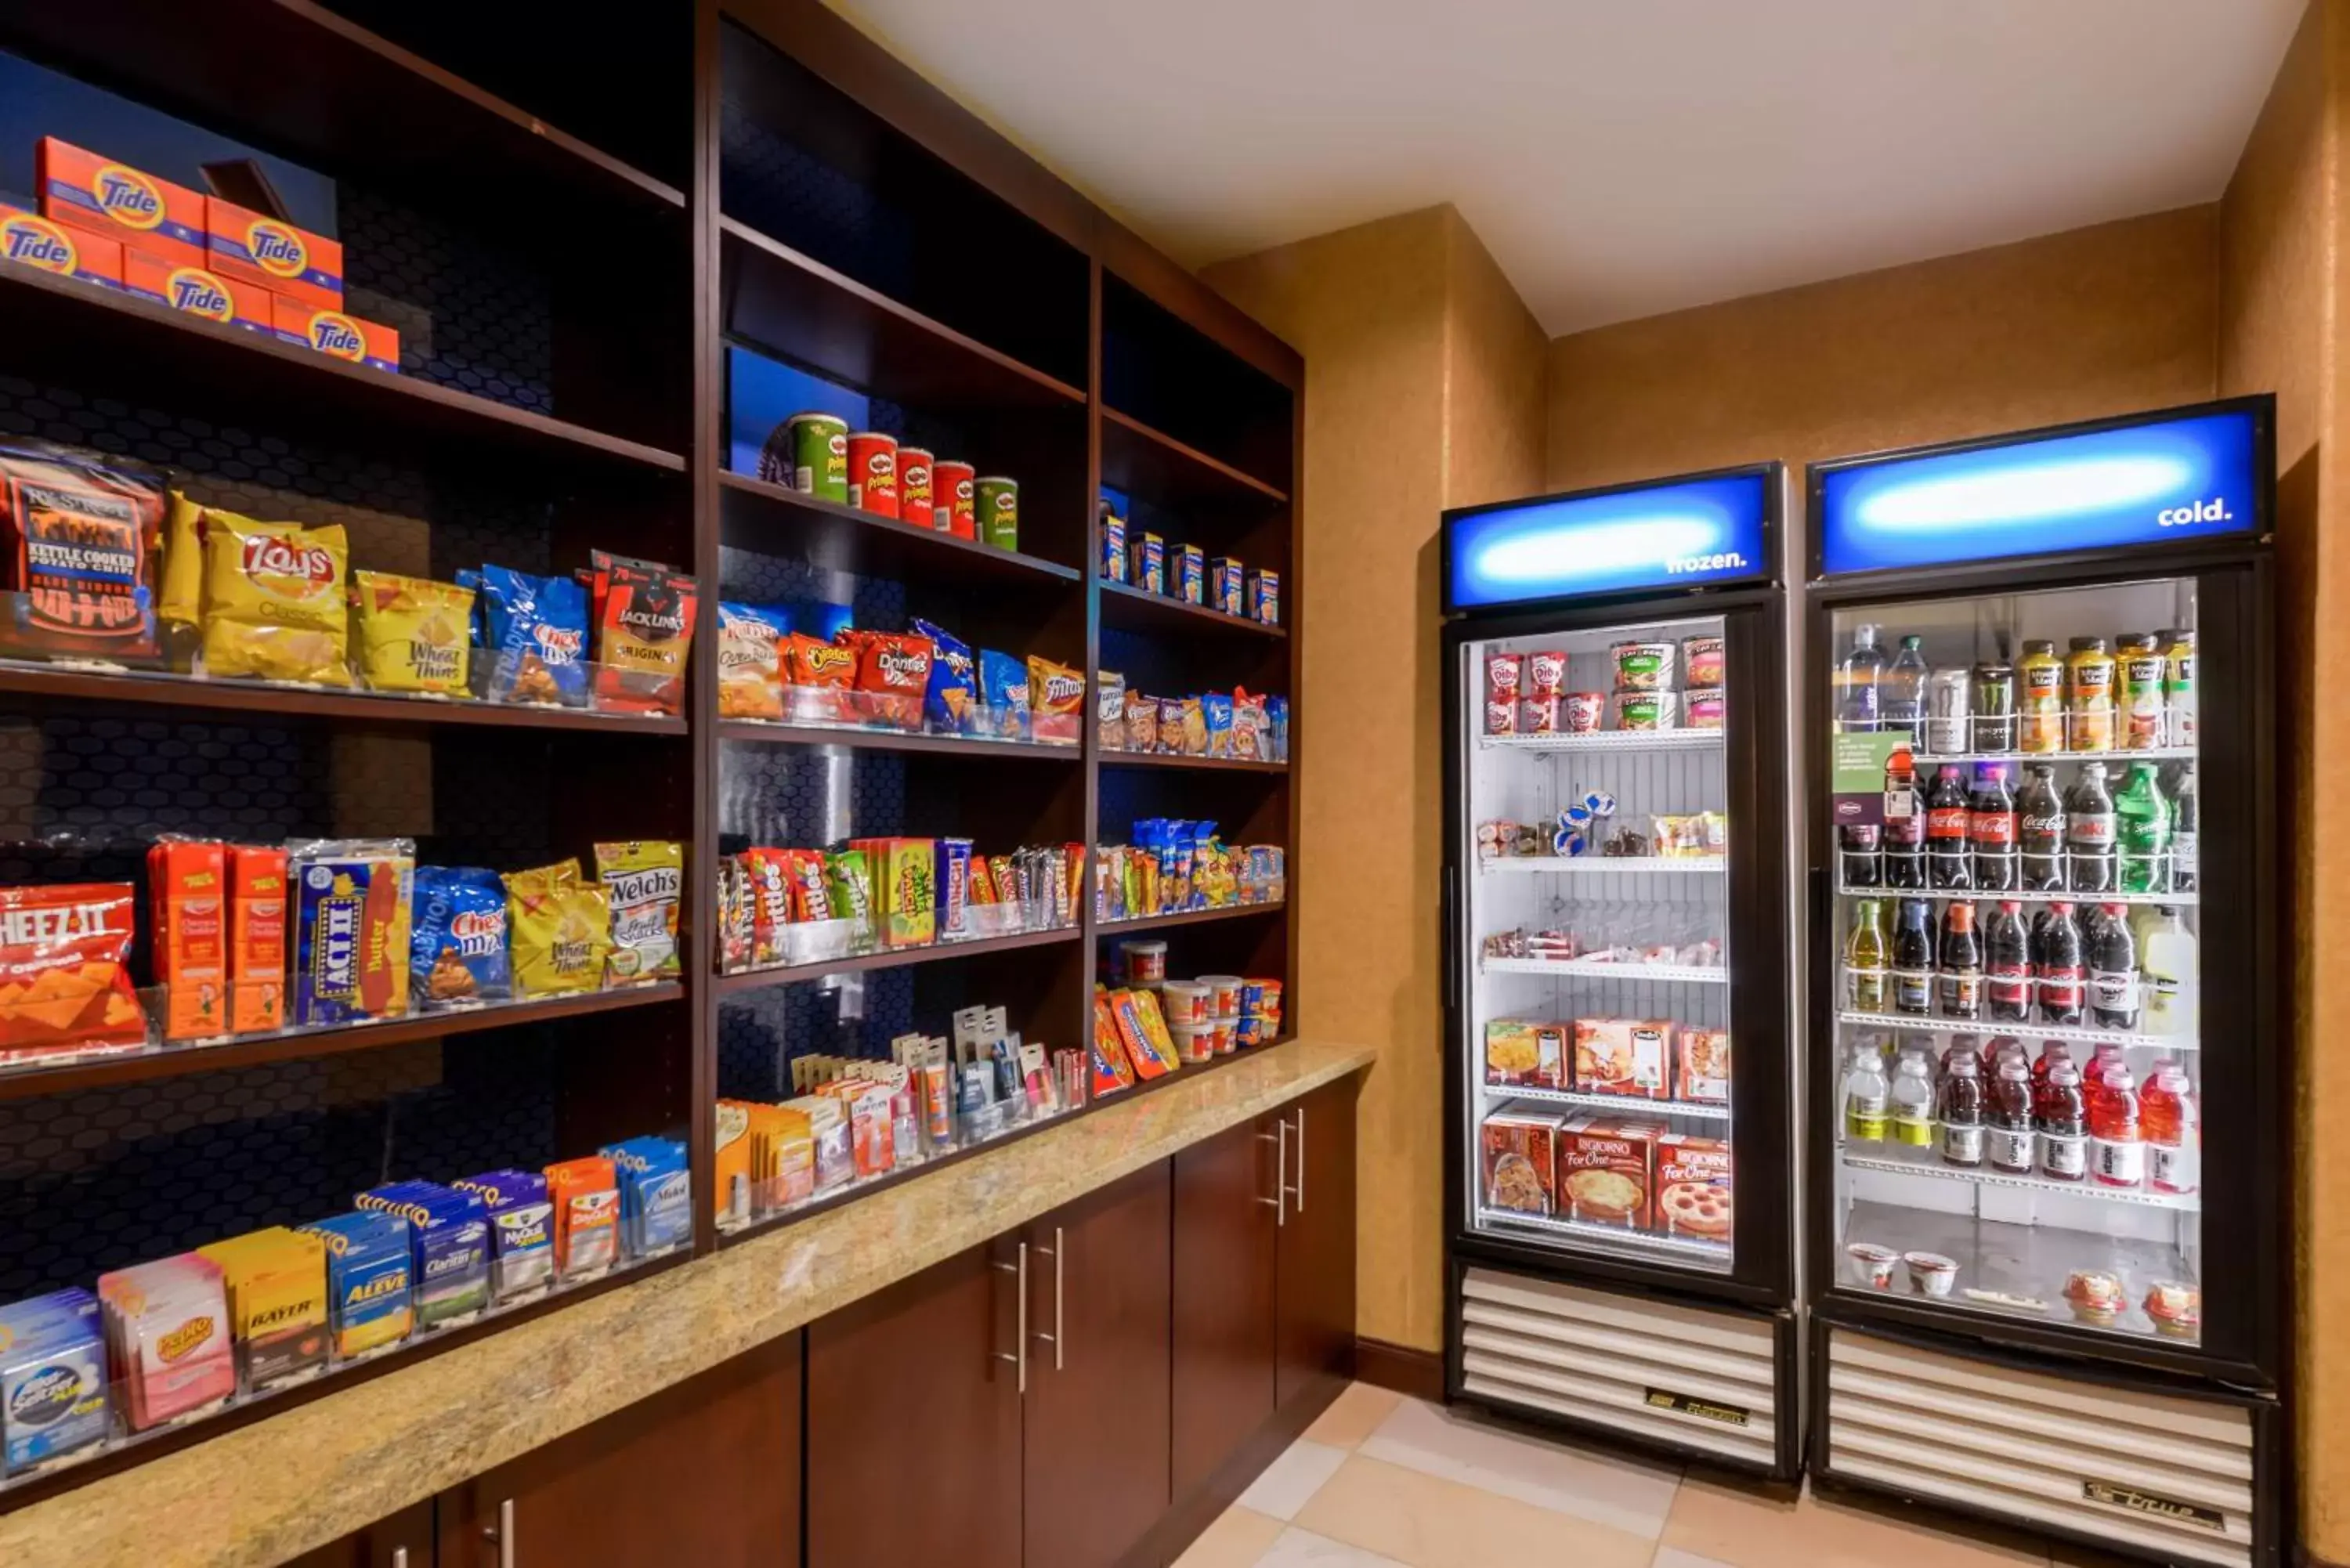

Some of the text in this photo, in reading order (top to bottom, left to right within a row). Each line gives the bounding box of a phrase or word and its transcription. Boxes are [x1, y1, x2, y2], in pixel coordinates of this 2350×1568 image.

[103, 179, 156, 212] Tide
[7, 229, 69, 262] Tide
[254, 231, 300, 261] Tide
[175, 281, 226, 311] Tide
[315, 322, 359, 352] Tide
[2158, 497, 2232, 527] cold.
[29, 543, 136, 568] KETTLE COOKED
[534, 623, 582, 650] Chex
[410, 641, 460, 667] Wheat
[408, 660, 460, 681] Thins
[1494, 667, 1517, 679] Dibs
[1046, 676, 1086, 703] Fritos
[2023, 815, 2067, 830] Coca-Cola
[610, 873, 678, 903] Welch's
[805, 862, 829, 921] ittles
[949, 861, 964, 929] CRUNCH
[0, 906, 106, 945] HEEZ-IT
[617, 927, 664, 945] Snacks
[627, 913, 656, 931] Fruit
[326, 908, 351, 985] ACT II
[368, 919, 385, 973] Butter
[1565, 1151, 1610, 1166] For One
[1662, 1165, 1712, 1180] For One
[505, 1222, 544, 1245] NyQuil
[425, 1252, 469, 1275] Claritin
[346, 1272, 407, 1302] ALEVE
[250, 1301, 313, 1329] BAYER
